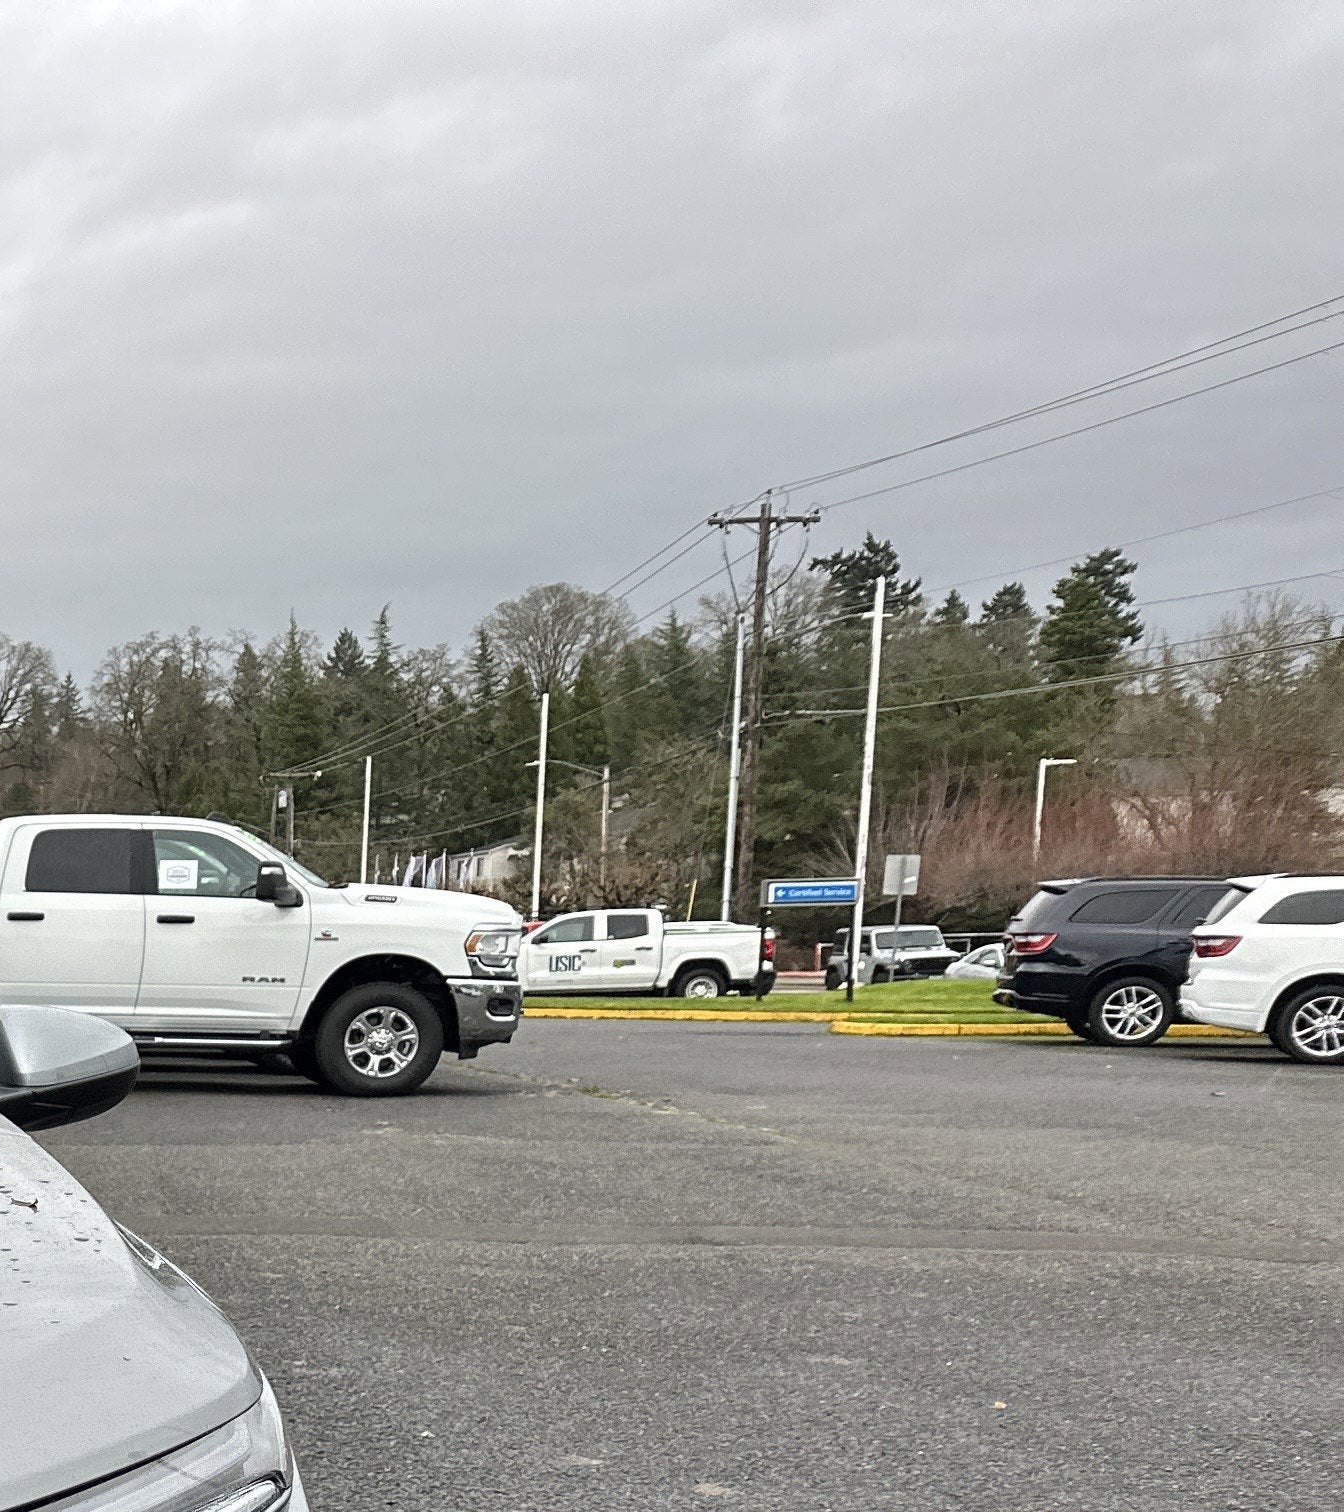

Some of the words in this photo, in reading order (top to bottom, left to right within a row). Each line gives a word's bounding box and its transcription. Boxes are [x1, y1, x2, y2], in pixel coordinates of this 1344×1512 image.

[788, 888, 823, 897] Certified
[824, 887, 852, 896] Service
[548, 954, 582, 972] USIC
